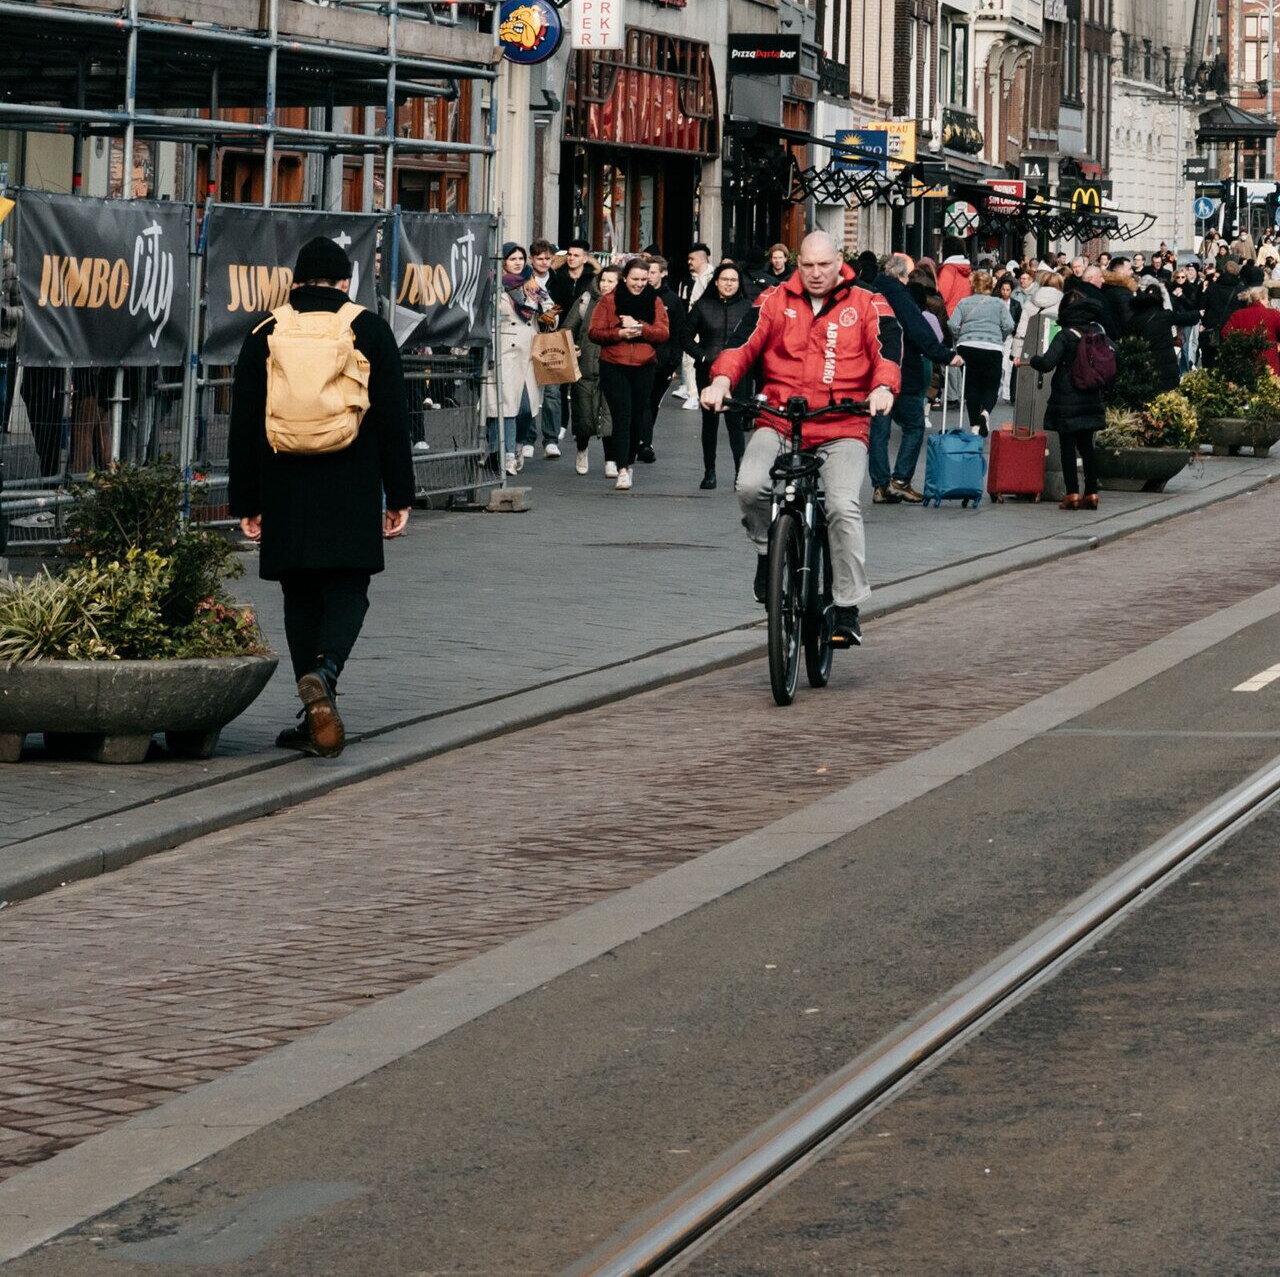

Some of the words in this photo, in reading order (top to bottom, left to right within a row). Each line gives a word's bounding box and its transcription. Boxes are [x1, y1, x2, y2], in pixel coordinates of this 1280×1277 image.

[38, 254, 129, 309] JUMBO
[129, 219, 173, 348] City
[227, 264, 294, 312] JUMB
